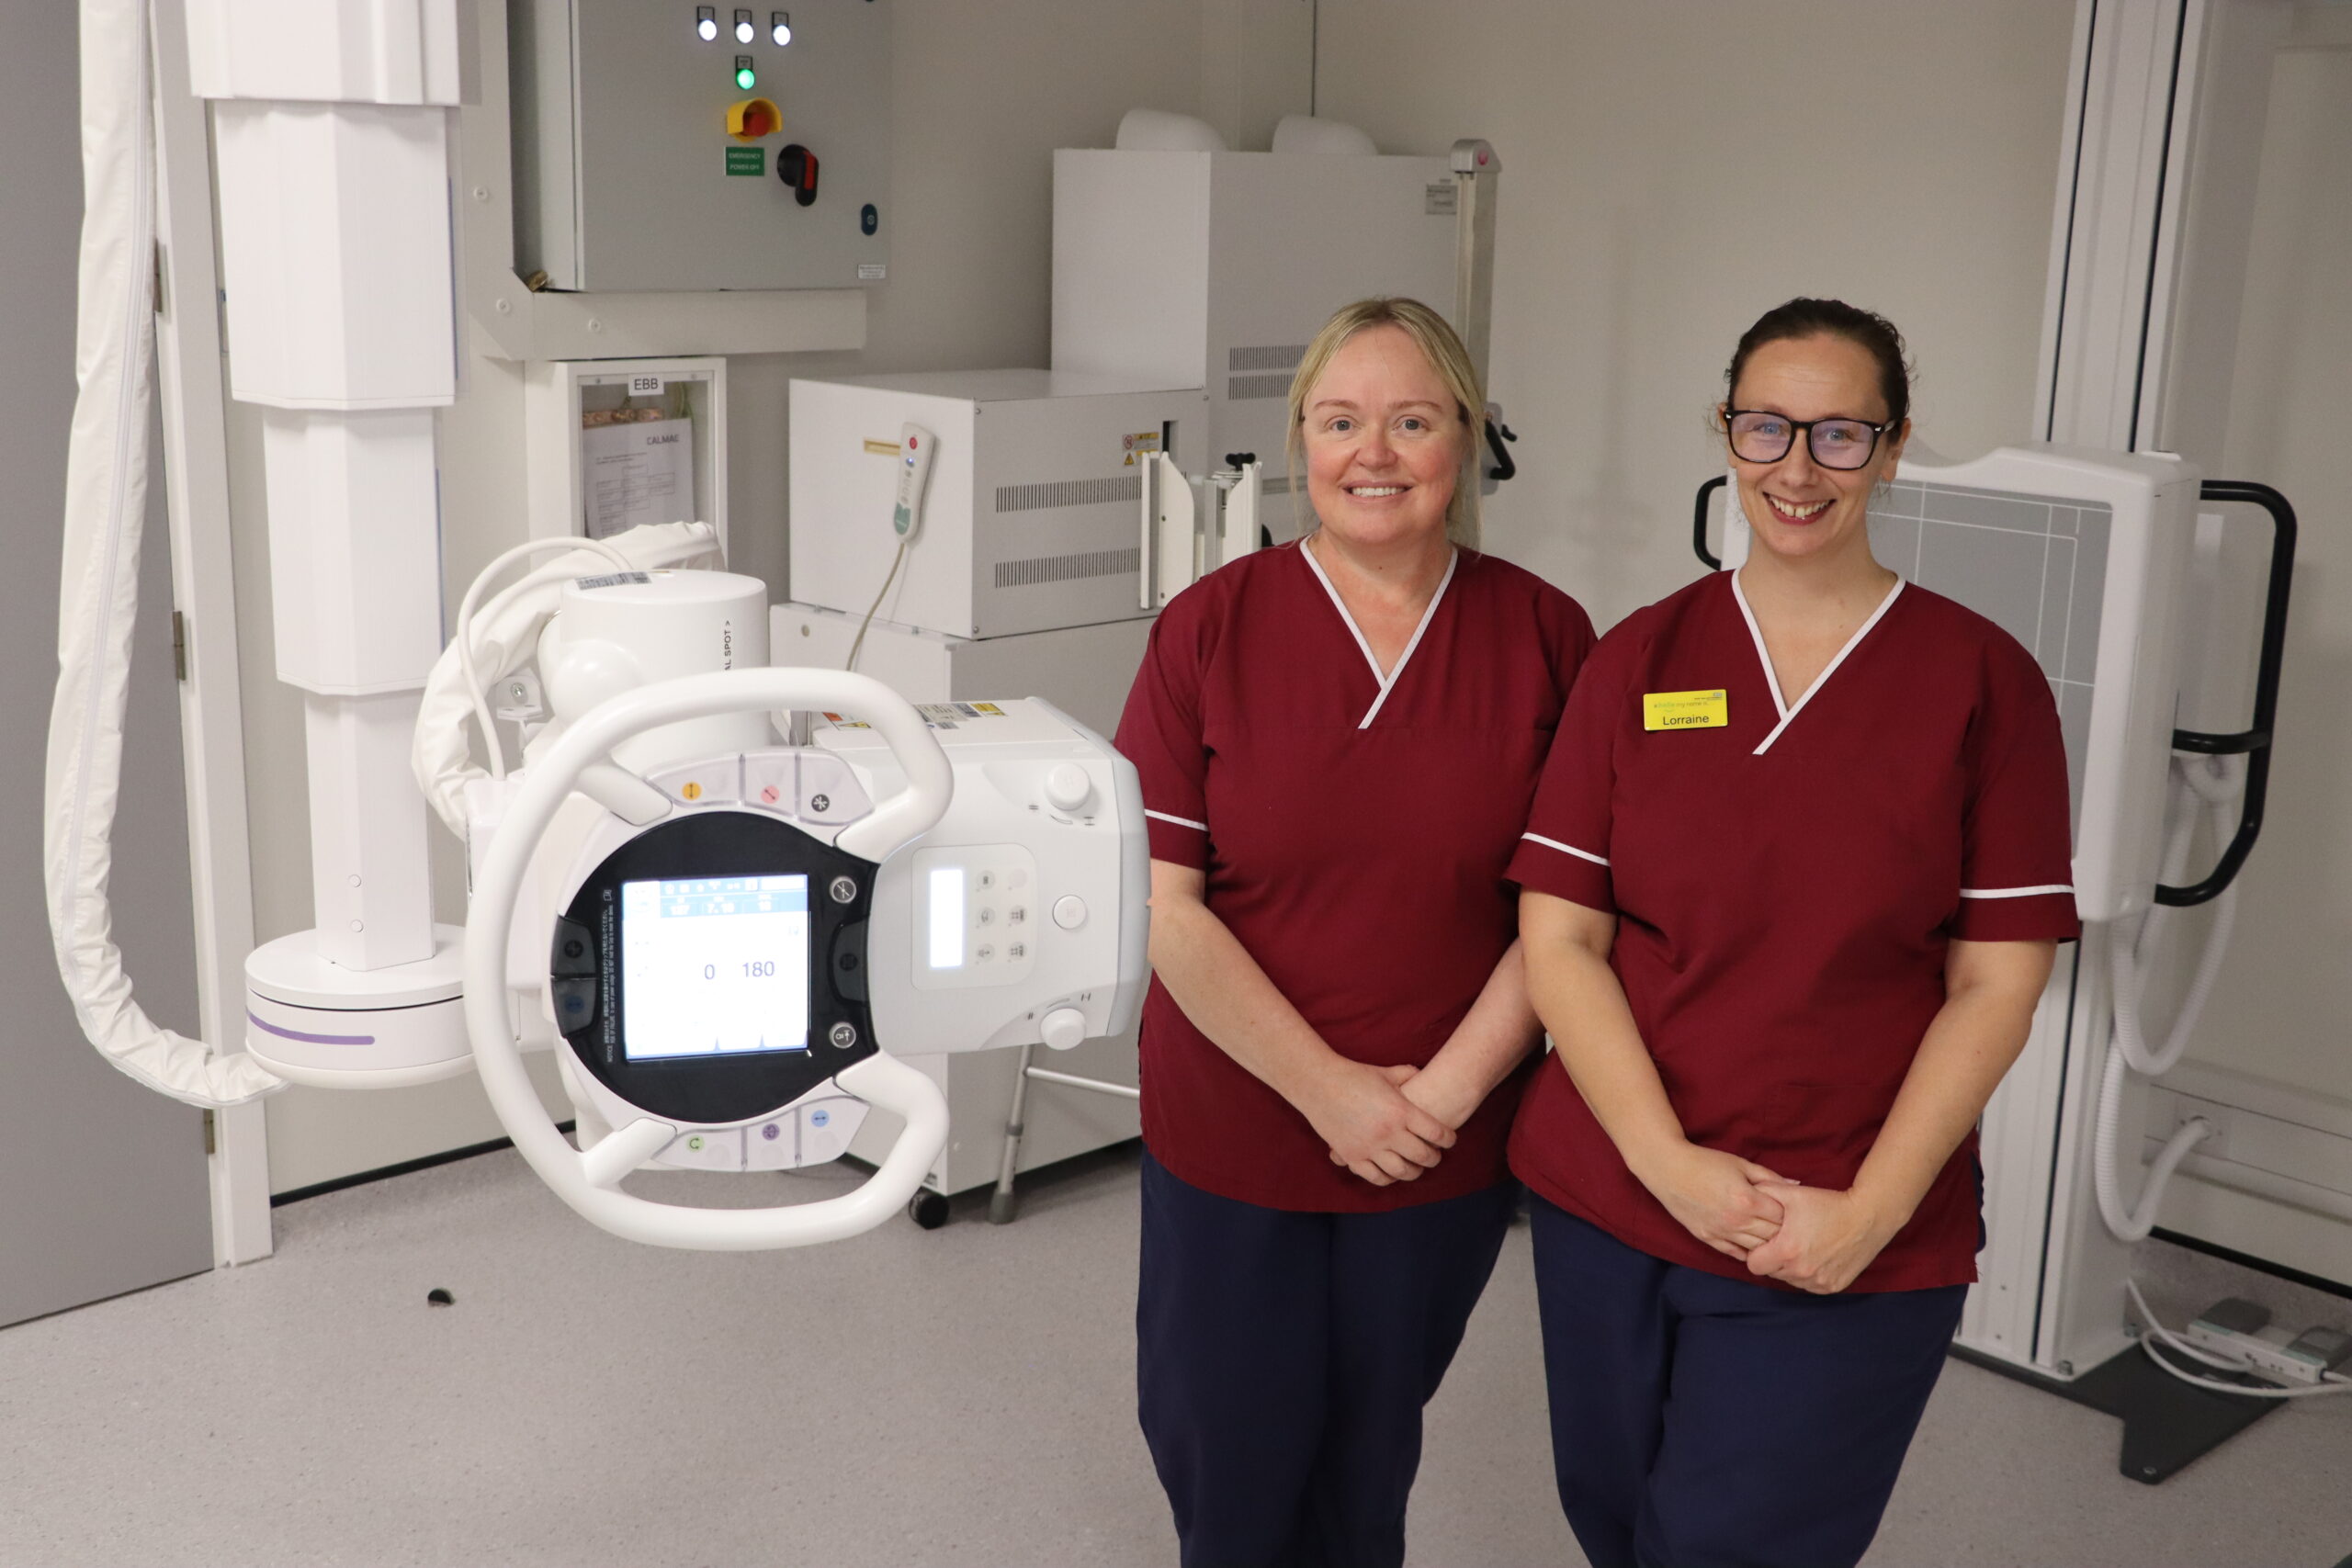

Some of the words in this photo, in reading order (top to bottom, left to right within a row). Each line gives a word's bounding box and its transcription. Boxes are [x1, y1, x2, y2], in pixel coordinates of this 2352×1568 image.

[634, 378, 659, 390] EBB
[1662, 714, 1710, 726] Lorraine
[704, 964, 716, 980] 0
[741, 960, 775, 978] 180
